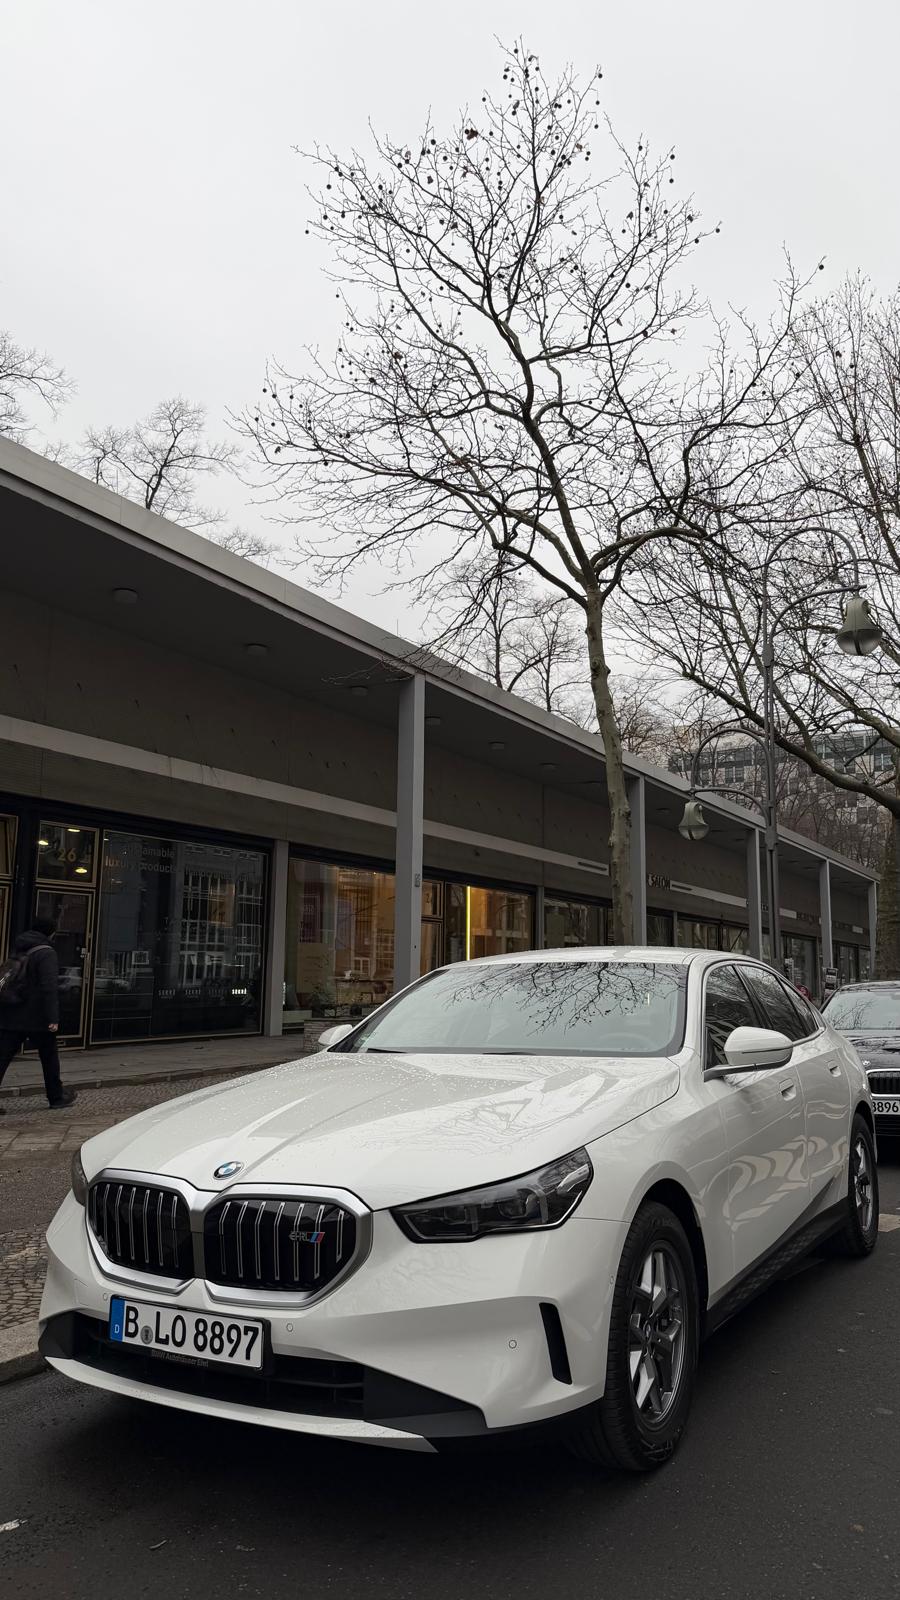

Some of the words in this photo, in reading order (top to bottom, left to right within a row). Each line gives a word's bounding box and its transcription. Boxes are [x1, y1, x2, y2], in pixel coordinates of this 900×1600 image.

[58, 848, 77, 863] 26
[114, 1324, 120, 1334] D
[125, 1305, 139, 1338] B
[154, 1311, 187, 1347] LO
[193, 1318, 259, 1361] 8897
